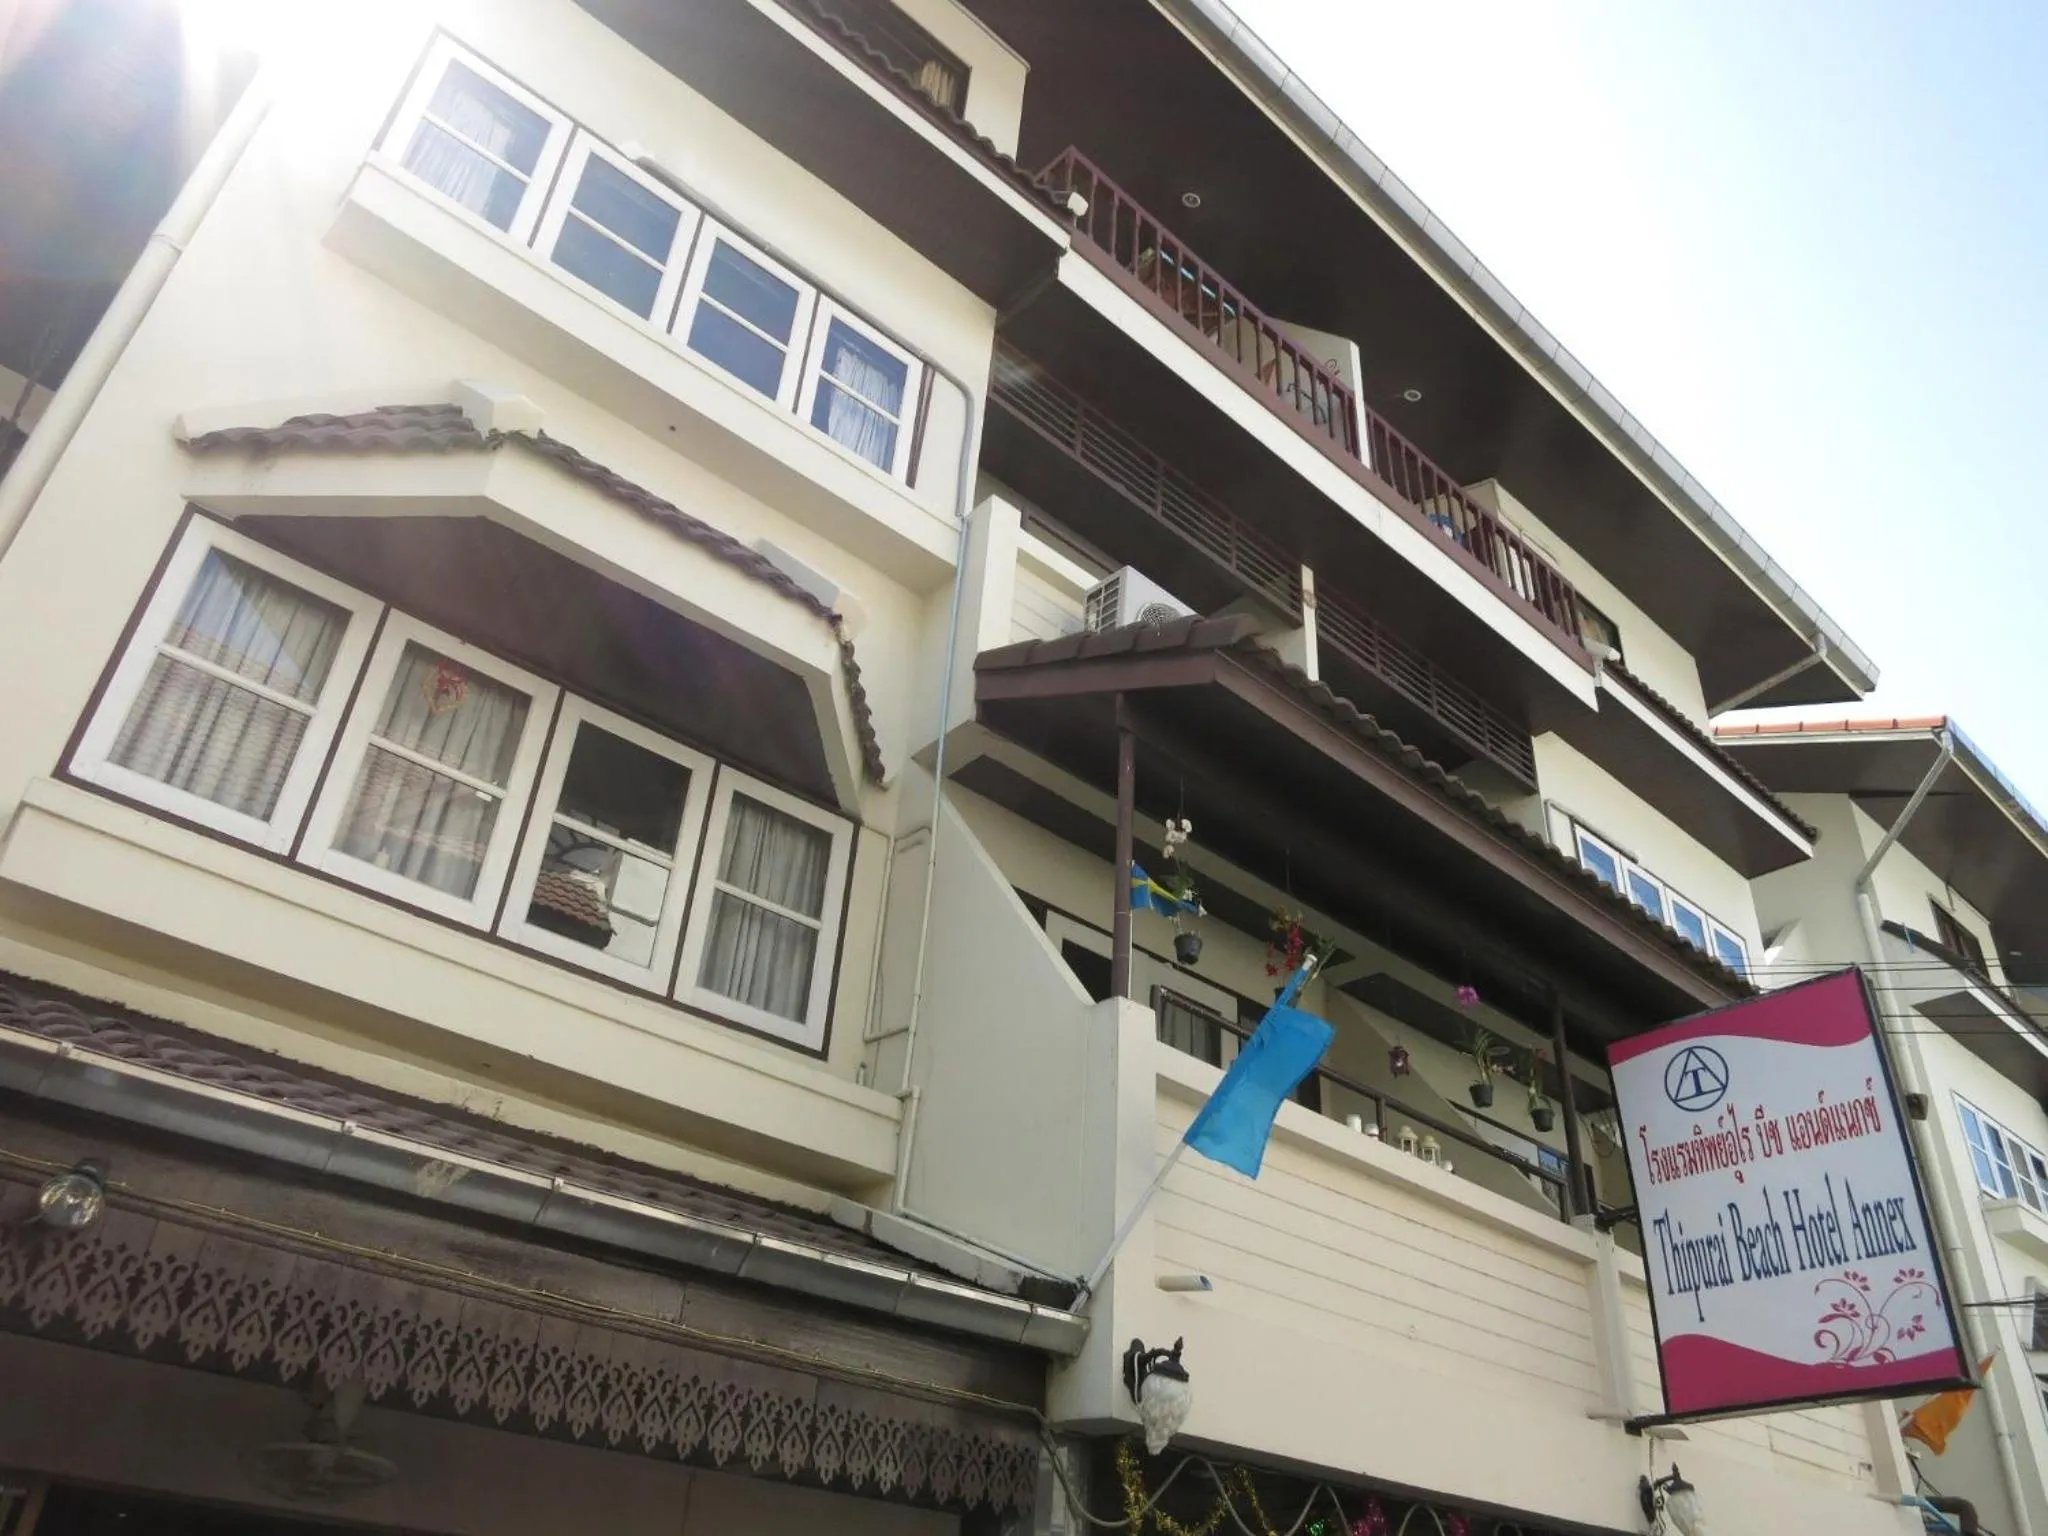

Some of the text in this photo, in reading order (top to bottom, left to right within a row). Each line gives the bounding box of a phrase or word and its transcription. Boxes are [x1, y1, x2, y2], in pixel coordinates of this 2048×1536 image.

[1639, 1103, 1754, 1184] โรงแรมทิพย์อุไร
[1653, 1171, 1917, 1322] Thipurai Beach Hotel Annex
